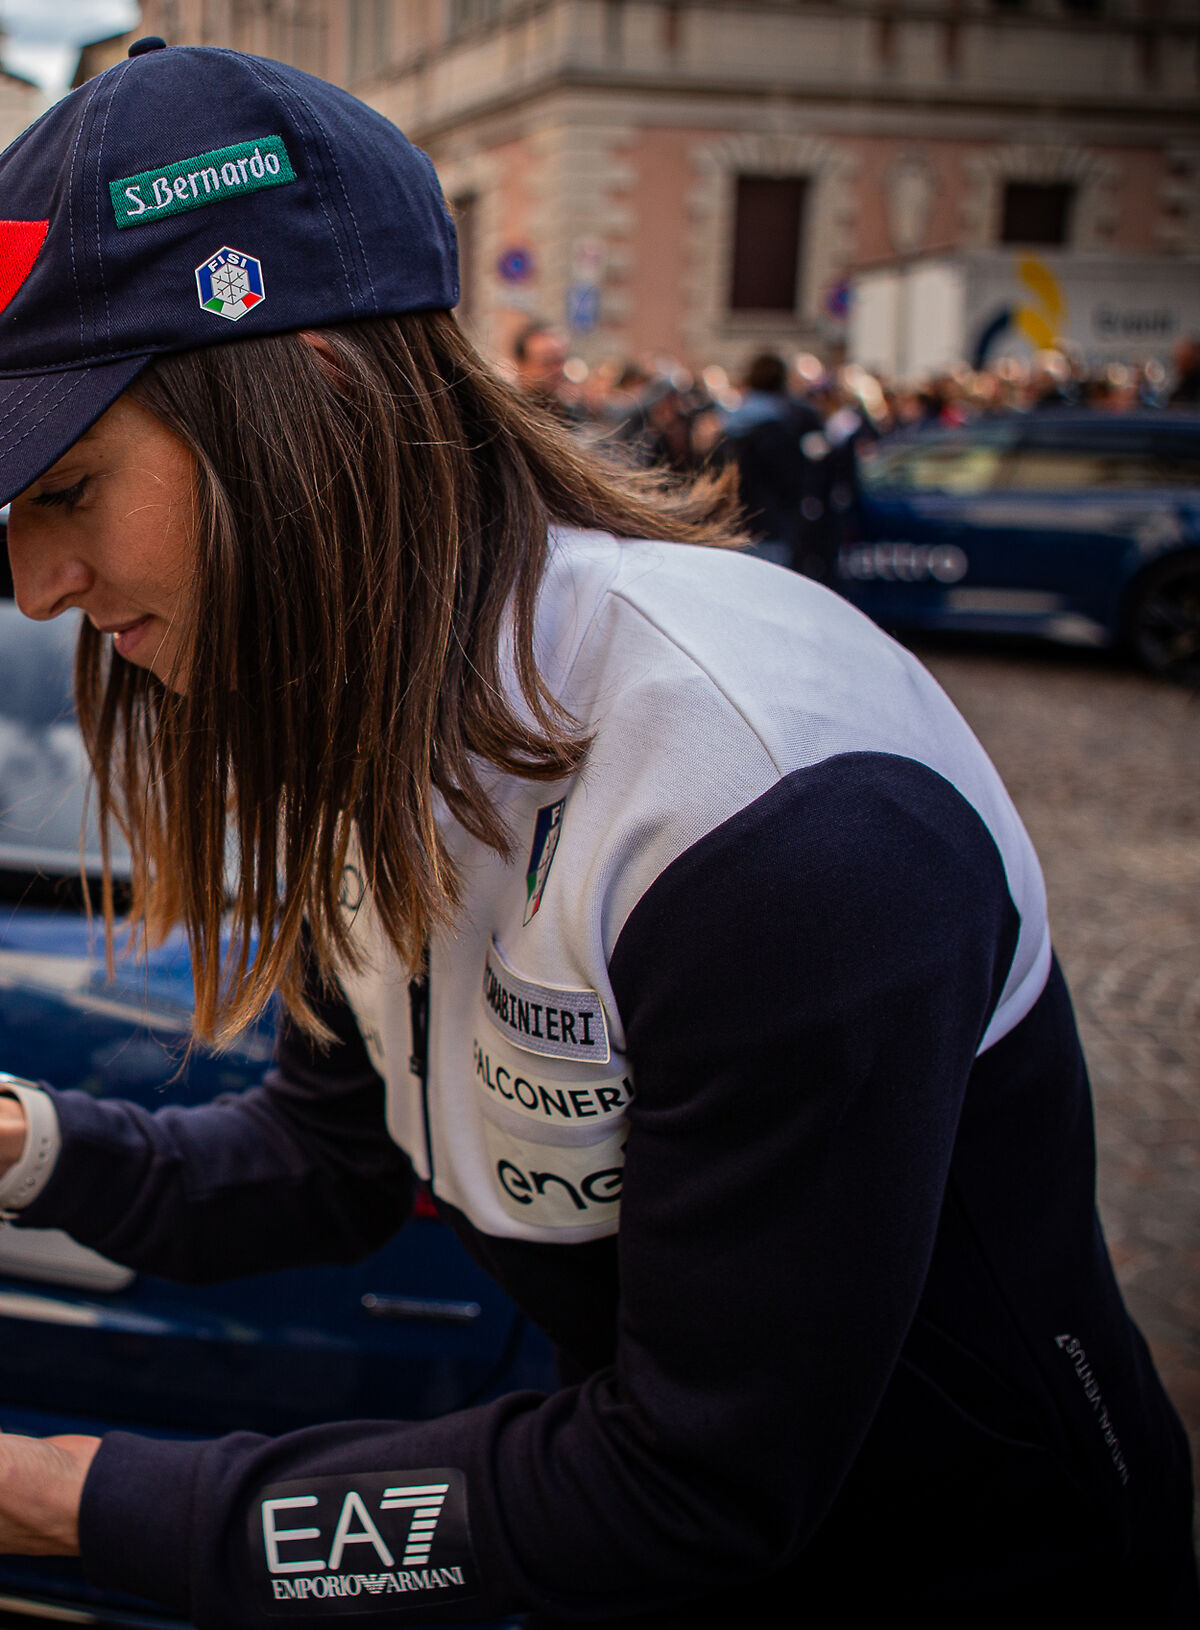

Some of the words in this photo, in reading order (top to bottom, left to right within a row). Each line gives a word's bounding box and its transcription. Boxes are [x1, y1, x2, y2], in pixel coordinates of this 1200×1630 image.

[125, 147, 281, 216] S.Bernardo
[208, 253, 248, 273] FISI
[497, 1143, 627, 1210] ene
[261, 1484, 450, 1575] EA7
[270, 1574, 363, 1600] EMPORIO
[386, 1566, 467, 1594] ARMANI
